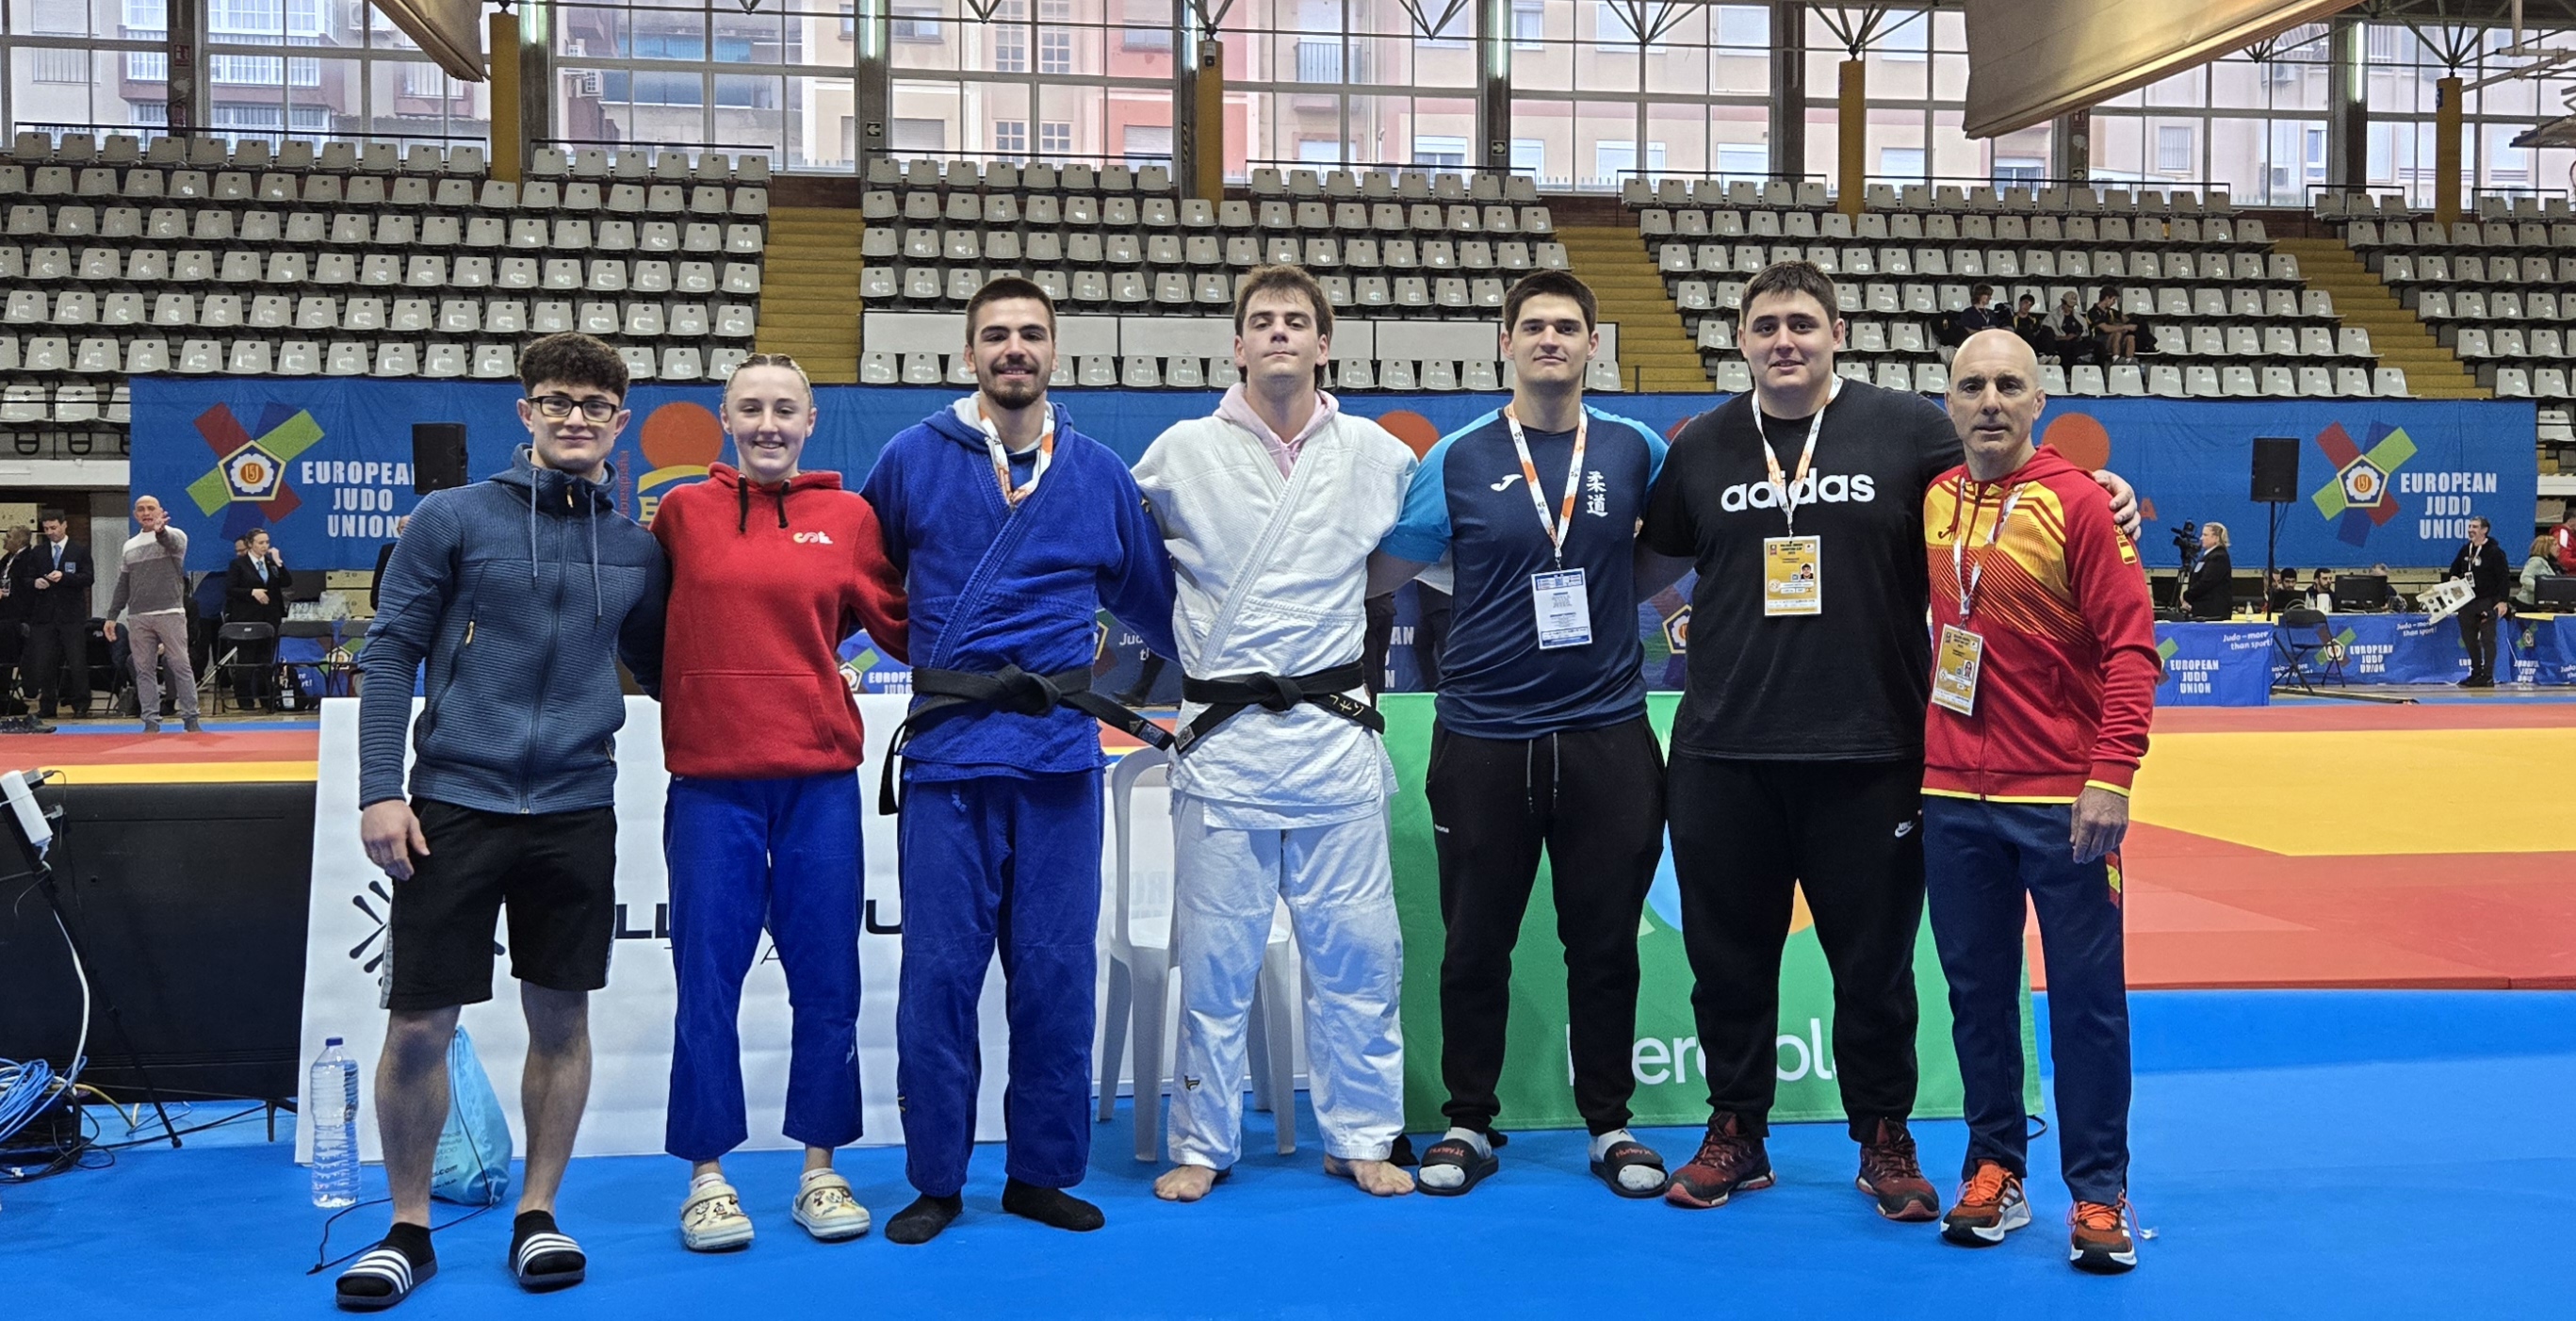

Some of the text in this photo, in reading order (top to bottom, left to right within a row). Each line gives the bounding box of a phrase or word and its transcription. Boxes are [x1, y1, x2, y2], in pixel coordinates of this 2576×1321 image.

[302, 461, 416, 485] EUROPEA
[2400, 472, 2497, 493] EUROPEAN
[333, 487, 393, 512] JUDO
[1586, 470, 1608, 517] 柔道
[1720, 467, 1876, 512] addas
[2424, 496, 2471, 515] JUDO
[327, 514, 401, 538] UNION
[2170, 660, 2220, 671] EUROPEAN
[869, 671, 913, 684] EUROPE
[2182, 671, 2208, 682] JUDO
[2179, 682, 2211, 693] UNION
